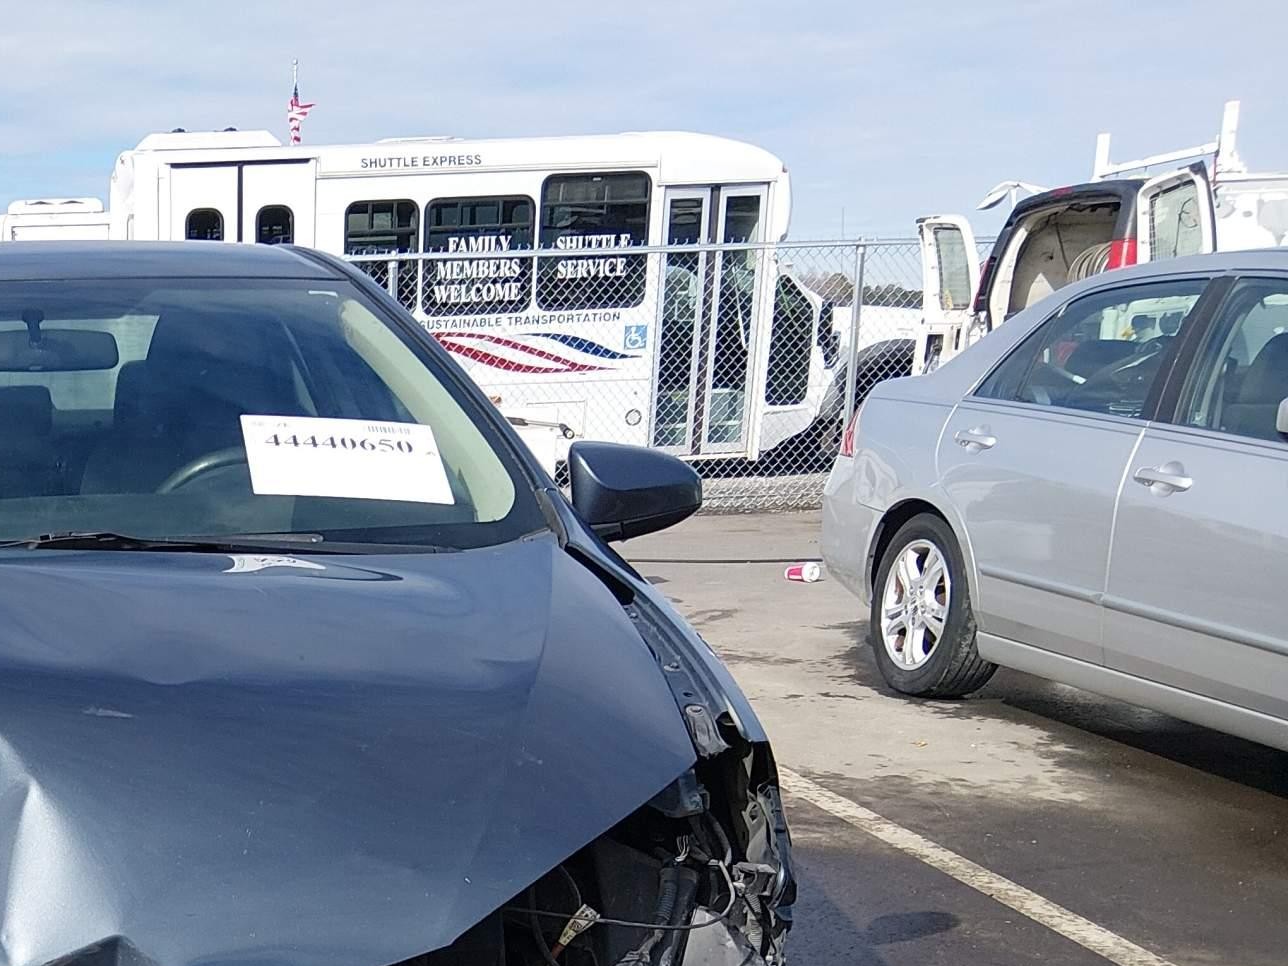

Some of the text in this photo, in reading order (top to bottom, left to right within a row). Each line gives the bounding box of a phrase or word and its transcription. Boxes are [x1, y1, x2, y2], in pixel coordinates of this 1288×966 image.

[361, 154, 482, 169] SHUTTLE EXPRESS
[448, 235, 512, 253] FAMILY
[556, 233, 631, 250] SHUTTLE
[436, 258, 522, 280] MEMBERS
[557, 258, 627, 279] SERVICE
[434, 282, 522, 303] WELCOME
[506, 311, 621, 327] TRANSPORTATION
[264, 433, 414, 453] 44440650
